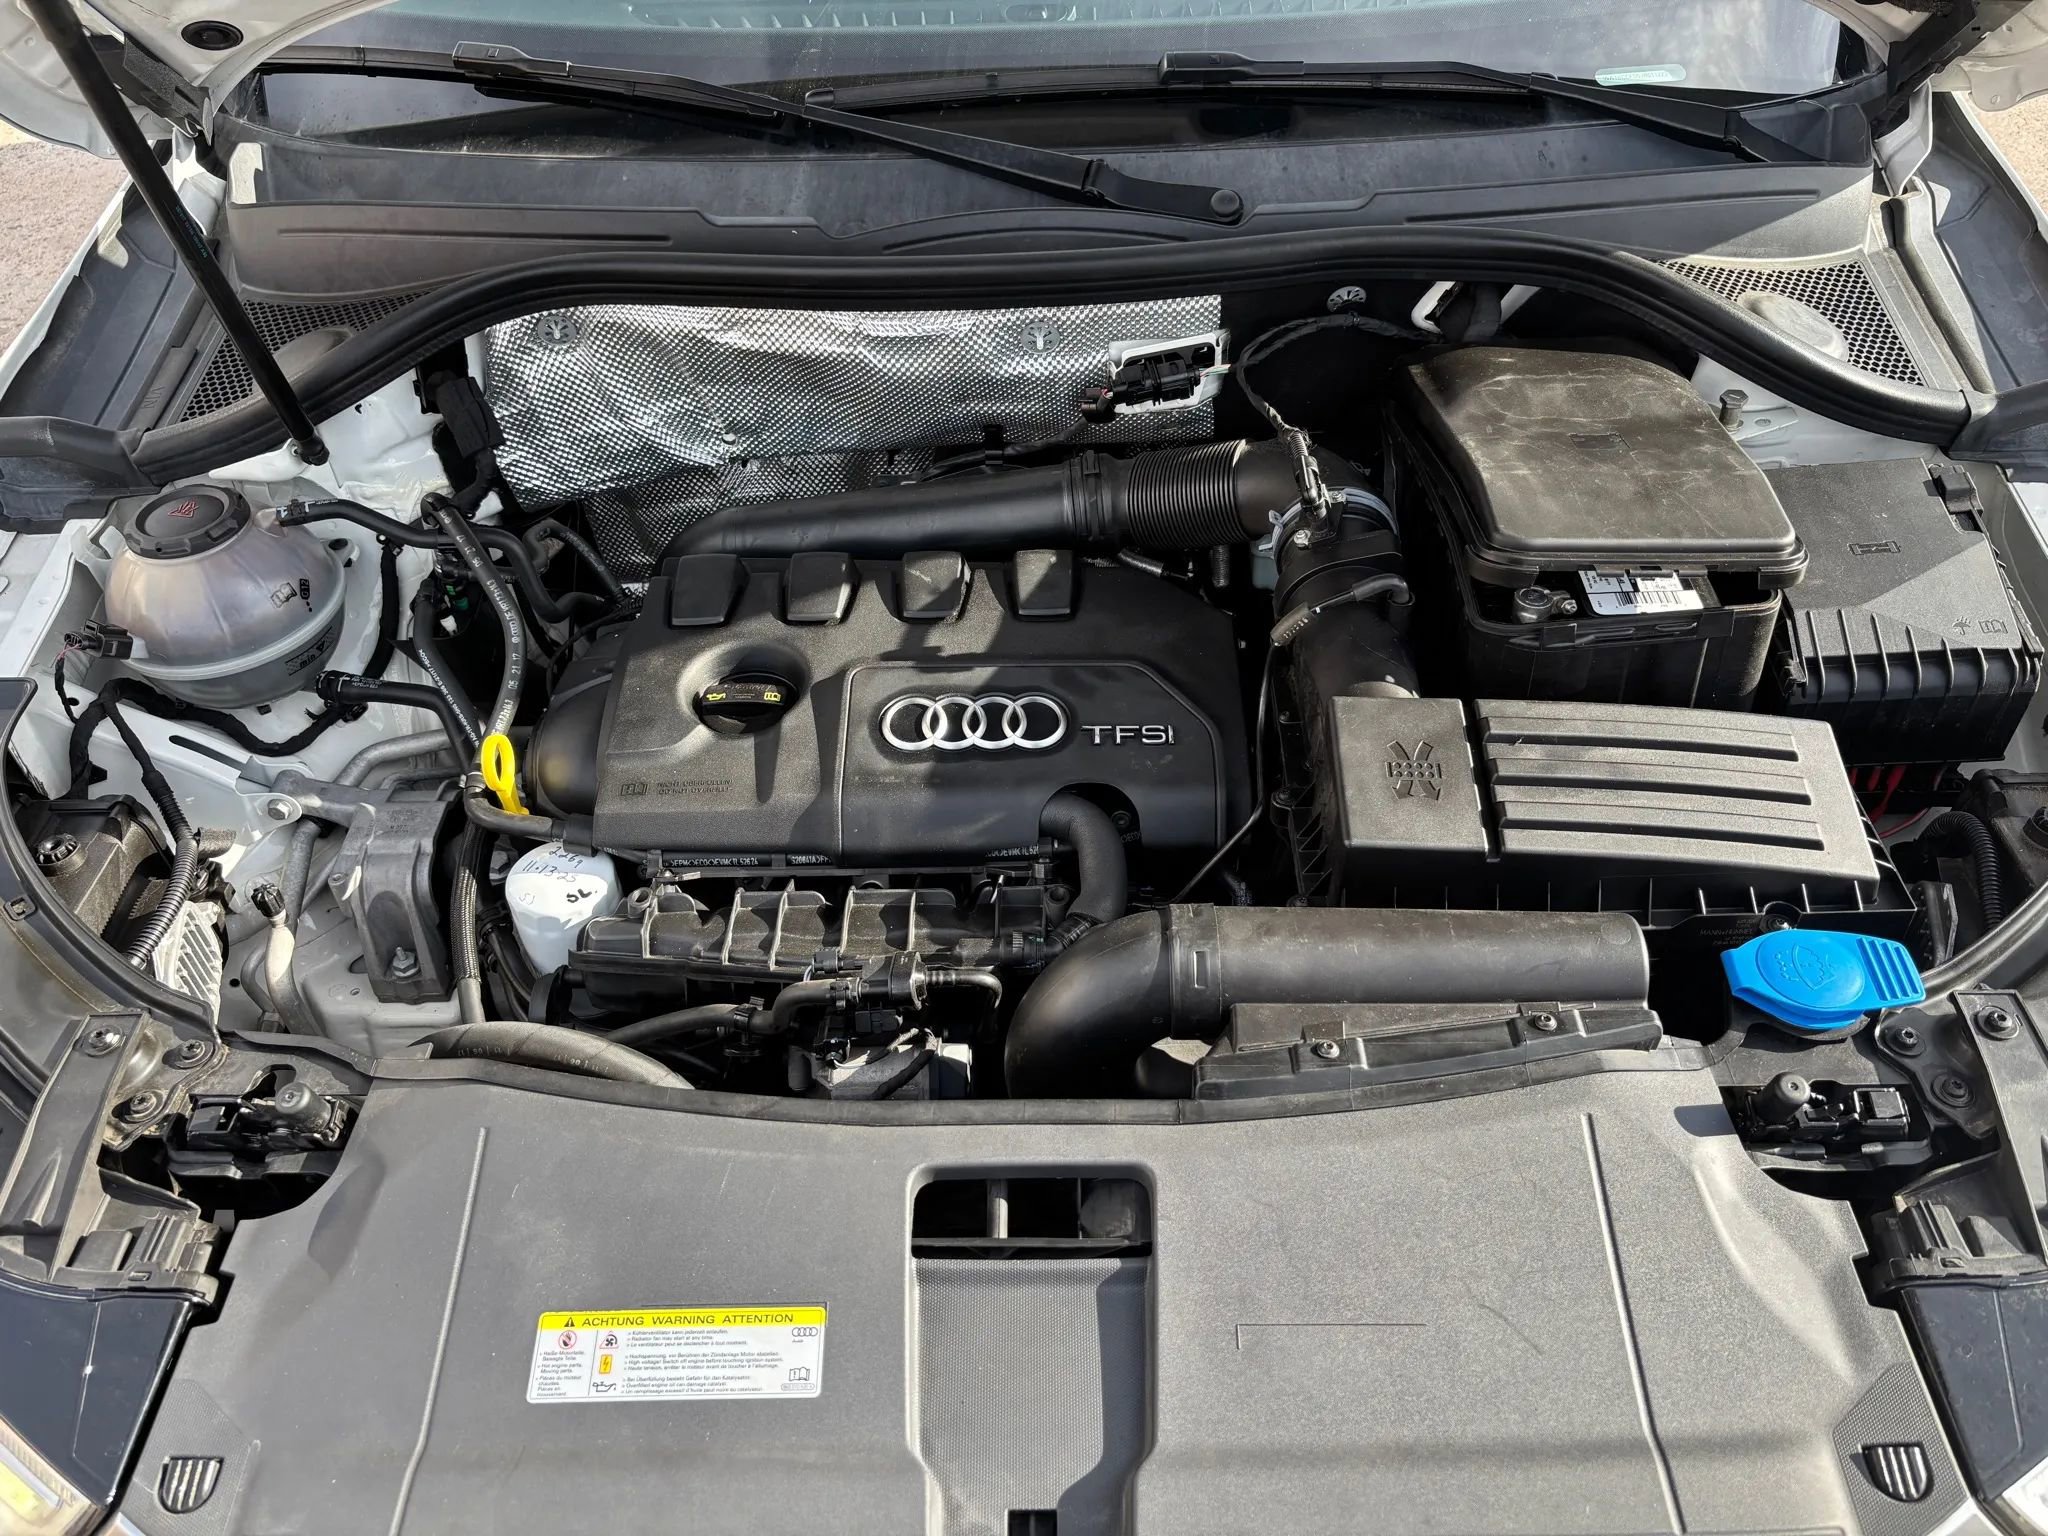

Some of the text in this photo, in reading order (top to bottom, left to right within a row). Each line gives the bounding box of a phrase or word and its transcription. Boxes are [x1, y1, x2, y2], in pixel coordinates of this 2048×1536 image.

[300, 580, 309, 598] G12
[299, 654, 316, 668] min
[1080, 724, 1175, 744] TFSI
[582, 1313, 794, 1327] ACHTUNG WARNING ATTENTION
